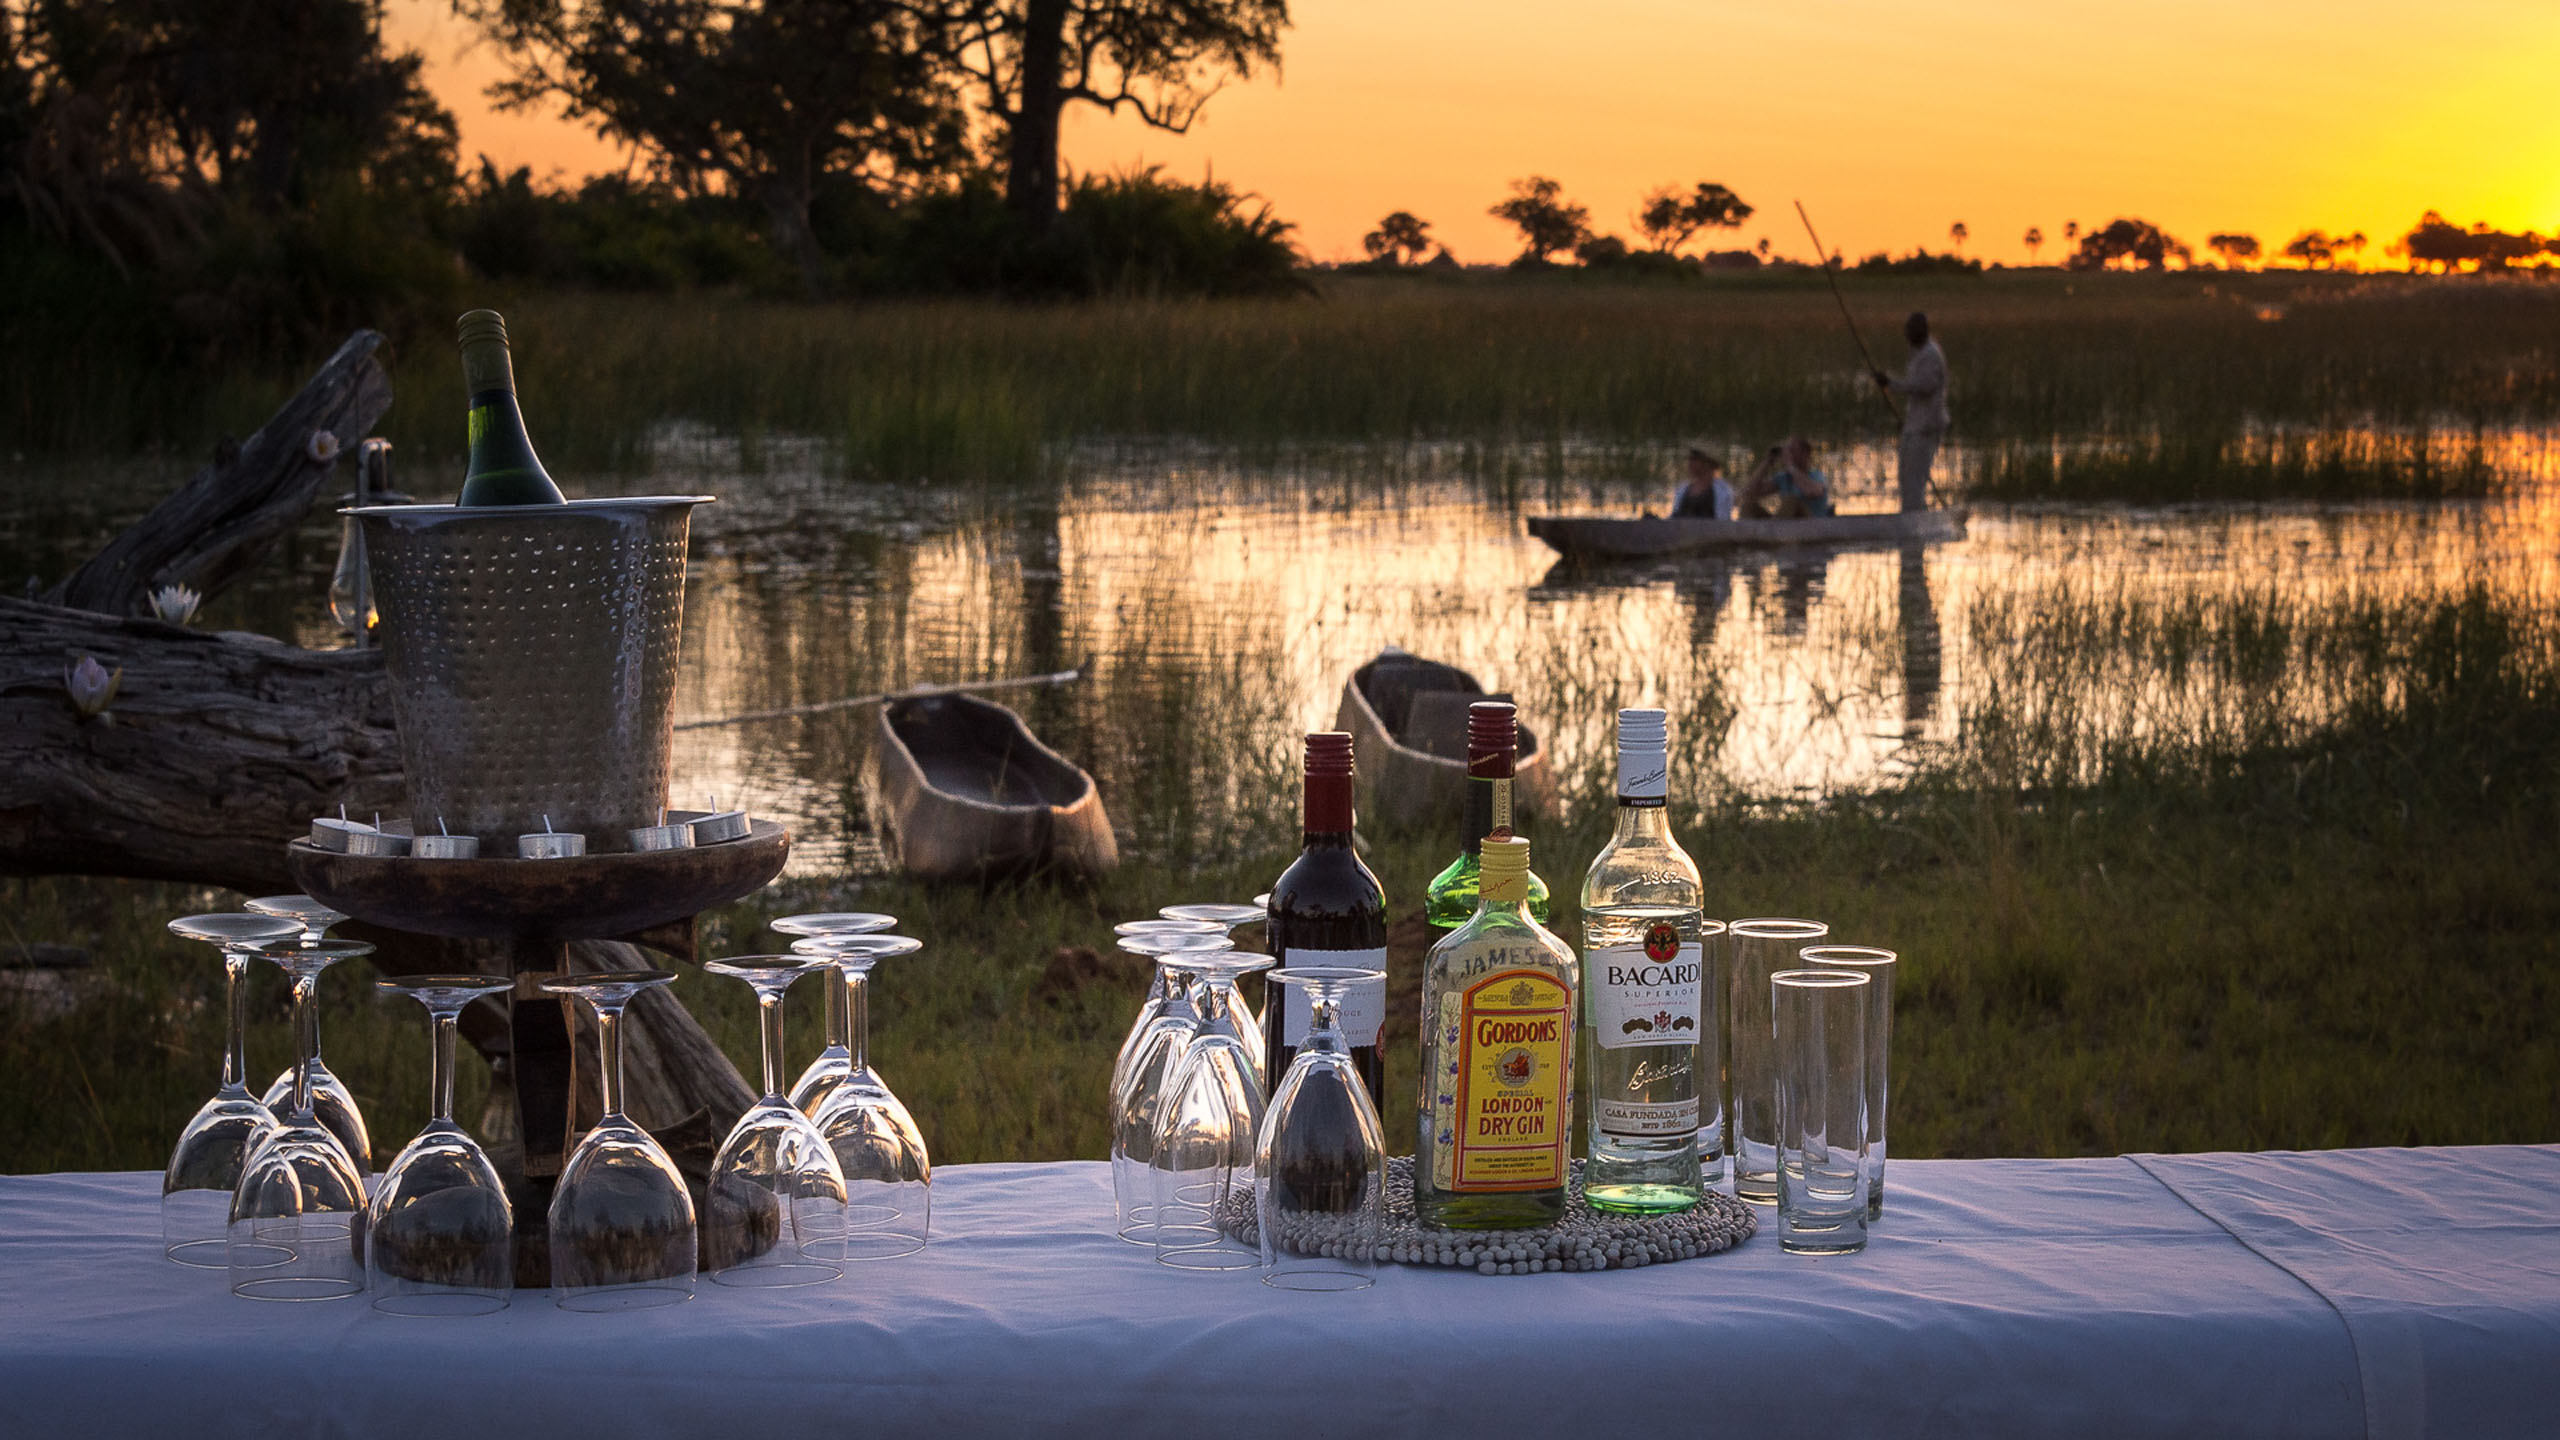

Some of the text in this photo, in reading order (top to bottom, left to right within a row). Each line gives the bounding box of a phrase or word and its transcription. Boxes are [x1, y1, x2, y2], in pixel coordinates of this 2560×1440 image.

[1641, 871, 1680, 886] 1862
[1481, 1096, 1544, 1114] LONDON
[1604, 1107, 1628, 1119] CASA
[1629, 1111, 1677, 1119] FUNDADA
[1478, 1115, 1544, 1136] DRY GIN
